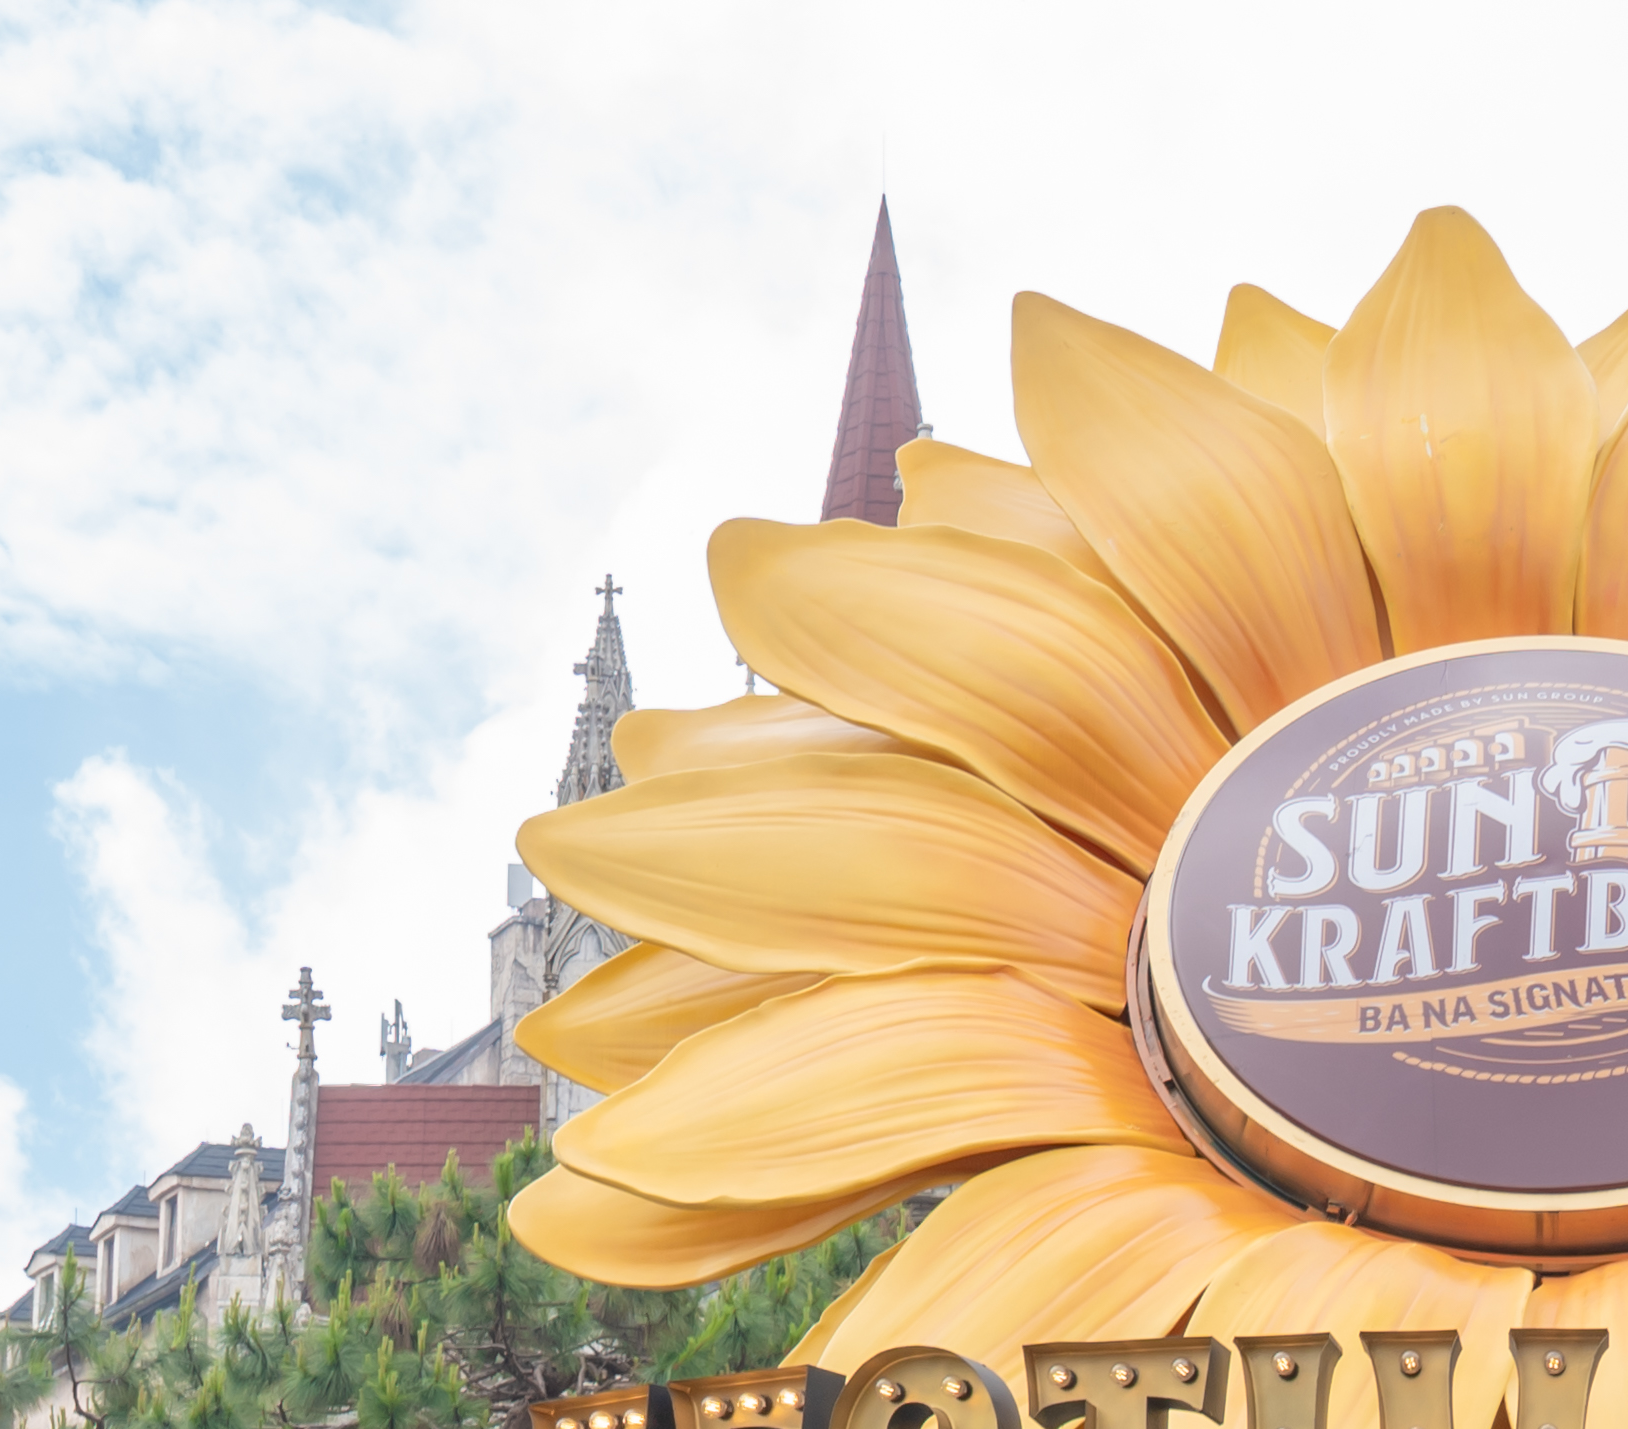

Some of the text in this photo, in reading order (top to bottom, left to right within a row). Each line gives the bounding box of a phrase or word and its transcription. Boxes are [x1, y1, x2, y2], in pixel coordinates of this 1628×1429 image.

[1328, 690, 1604, 772] PROUDLY MADE BY SUN GROUP
[1266, 766, 1544, 899] SUN
[1358, 1004, 1412, 1034] BA
[1422, 998, 1479, 1031] NA
